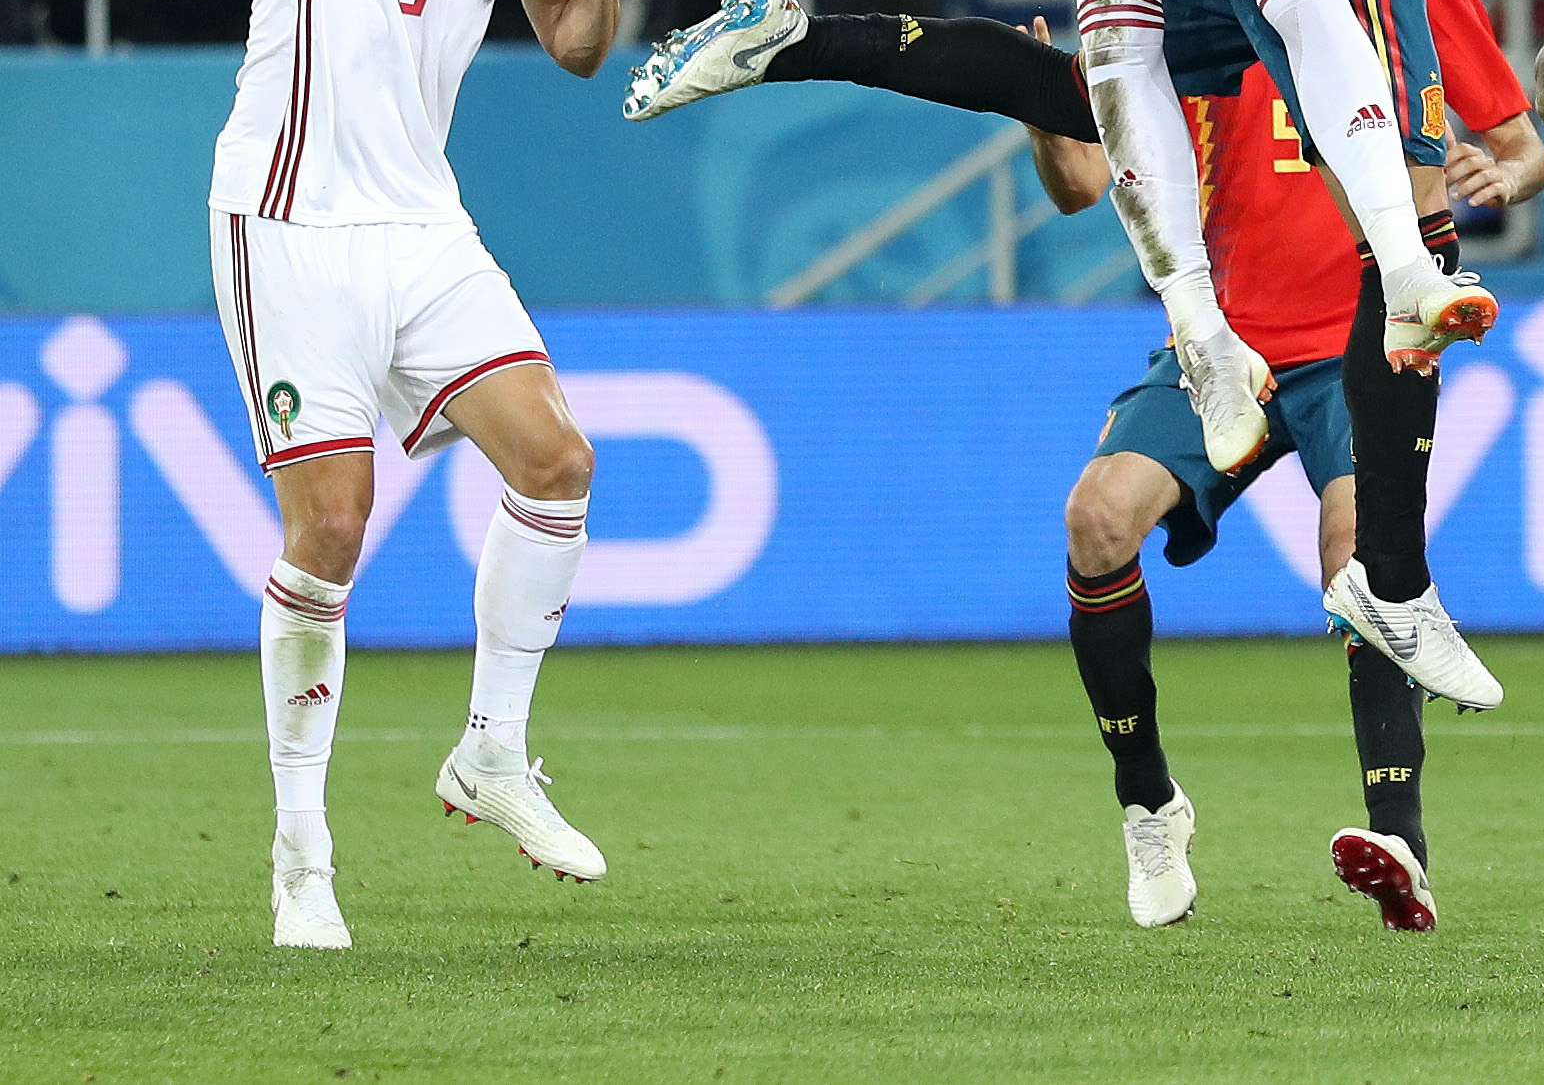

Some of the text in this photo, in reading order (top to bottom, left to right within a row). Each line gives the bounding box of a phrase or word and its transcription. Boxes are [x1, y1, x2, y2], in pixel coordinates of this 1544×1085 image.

[1272, 98, 1311, 173] 5
[1346, 117, 1393, 138] adidas
[0, 316, 778, 612] ivo
[287, 693, 335, 707] adidas
